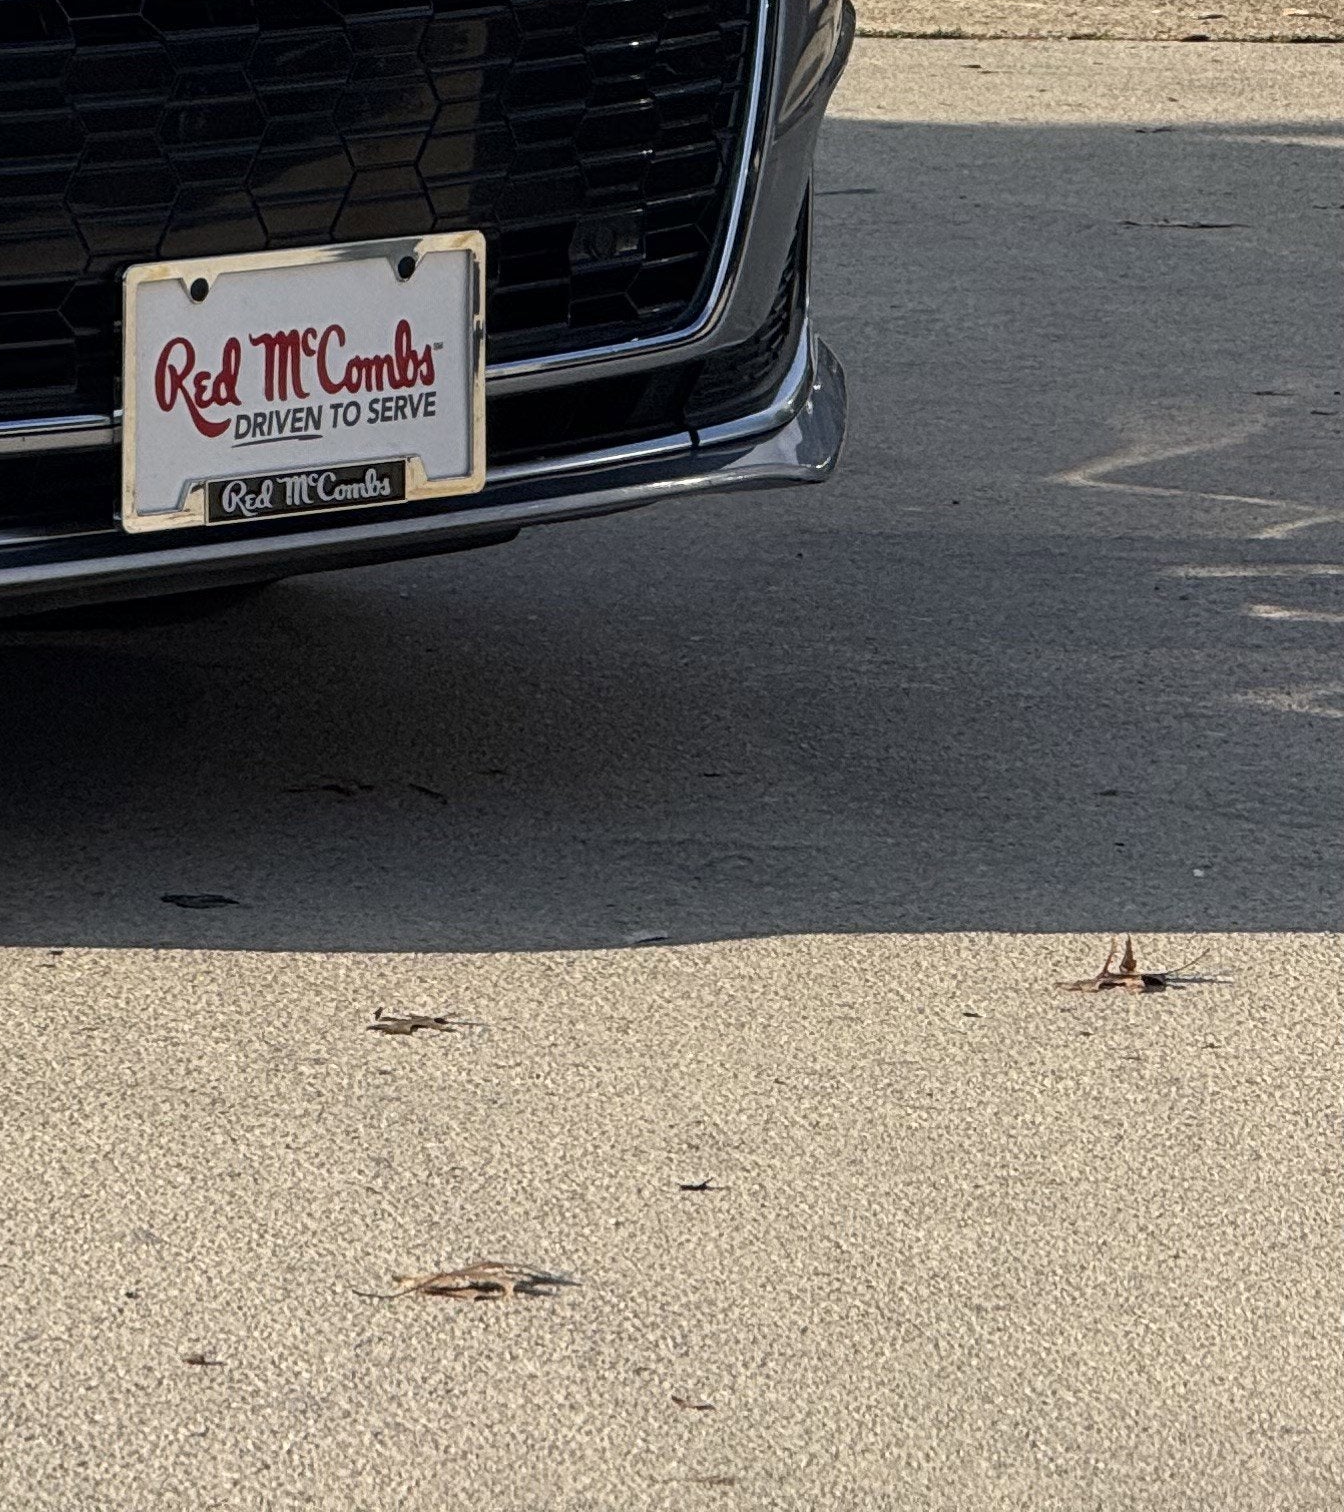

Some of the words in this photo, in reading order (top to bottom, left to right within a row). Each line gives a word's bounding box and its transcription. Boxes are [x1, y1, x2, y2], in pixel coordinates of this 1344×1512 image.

[155, 337, 242, 438] Red
[249, 318, 436, 402] McCombs
[234, 404, 322, 440] DRIVEN
[330, 400, 362, 429] TO
[368, 391, 437, 423] SERVE
[222, 480, 272, 516] Red
[277, 468, 391, 505] McCombs
